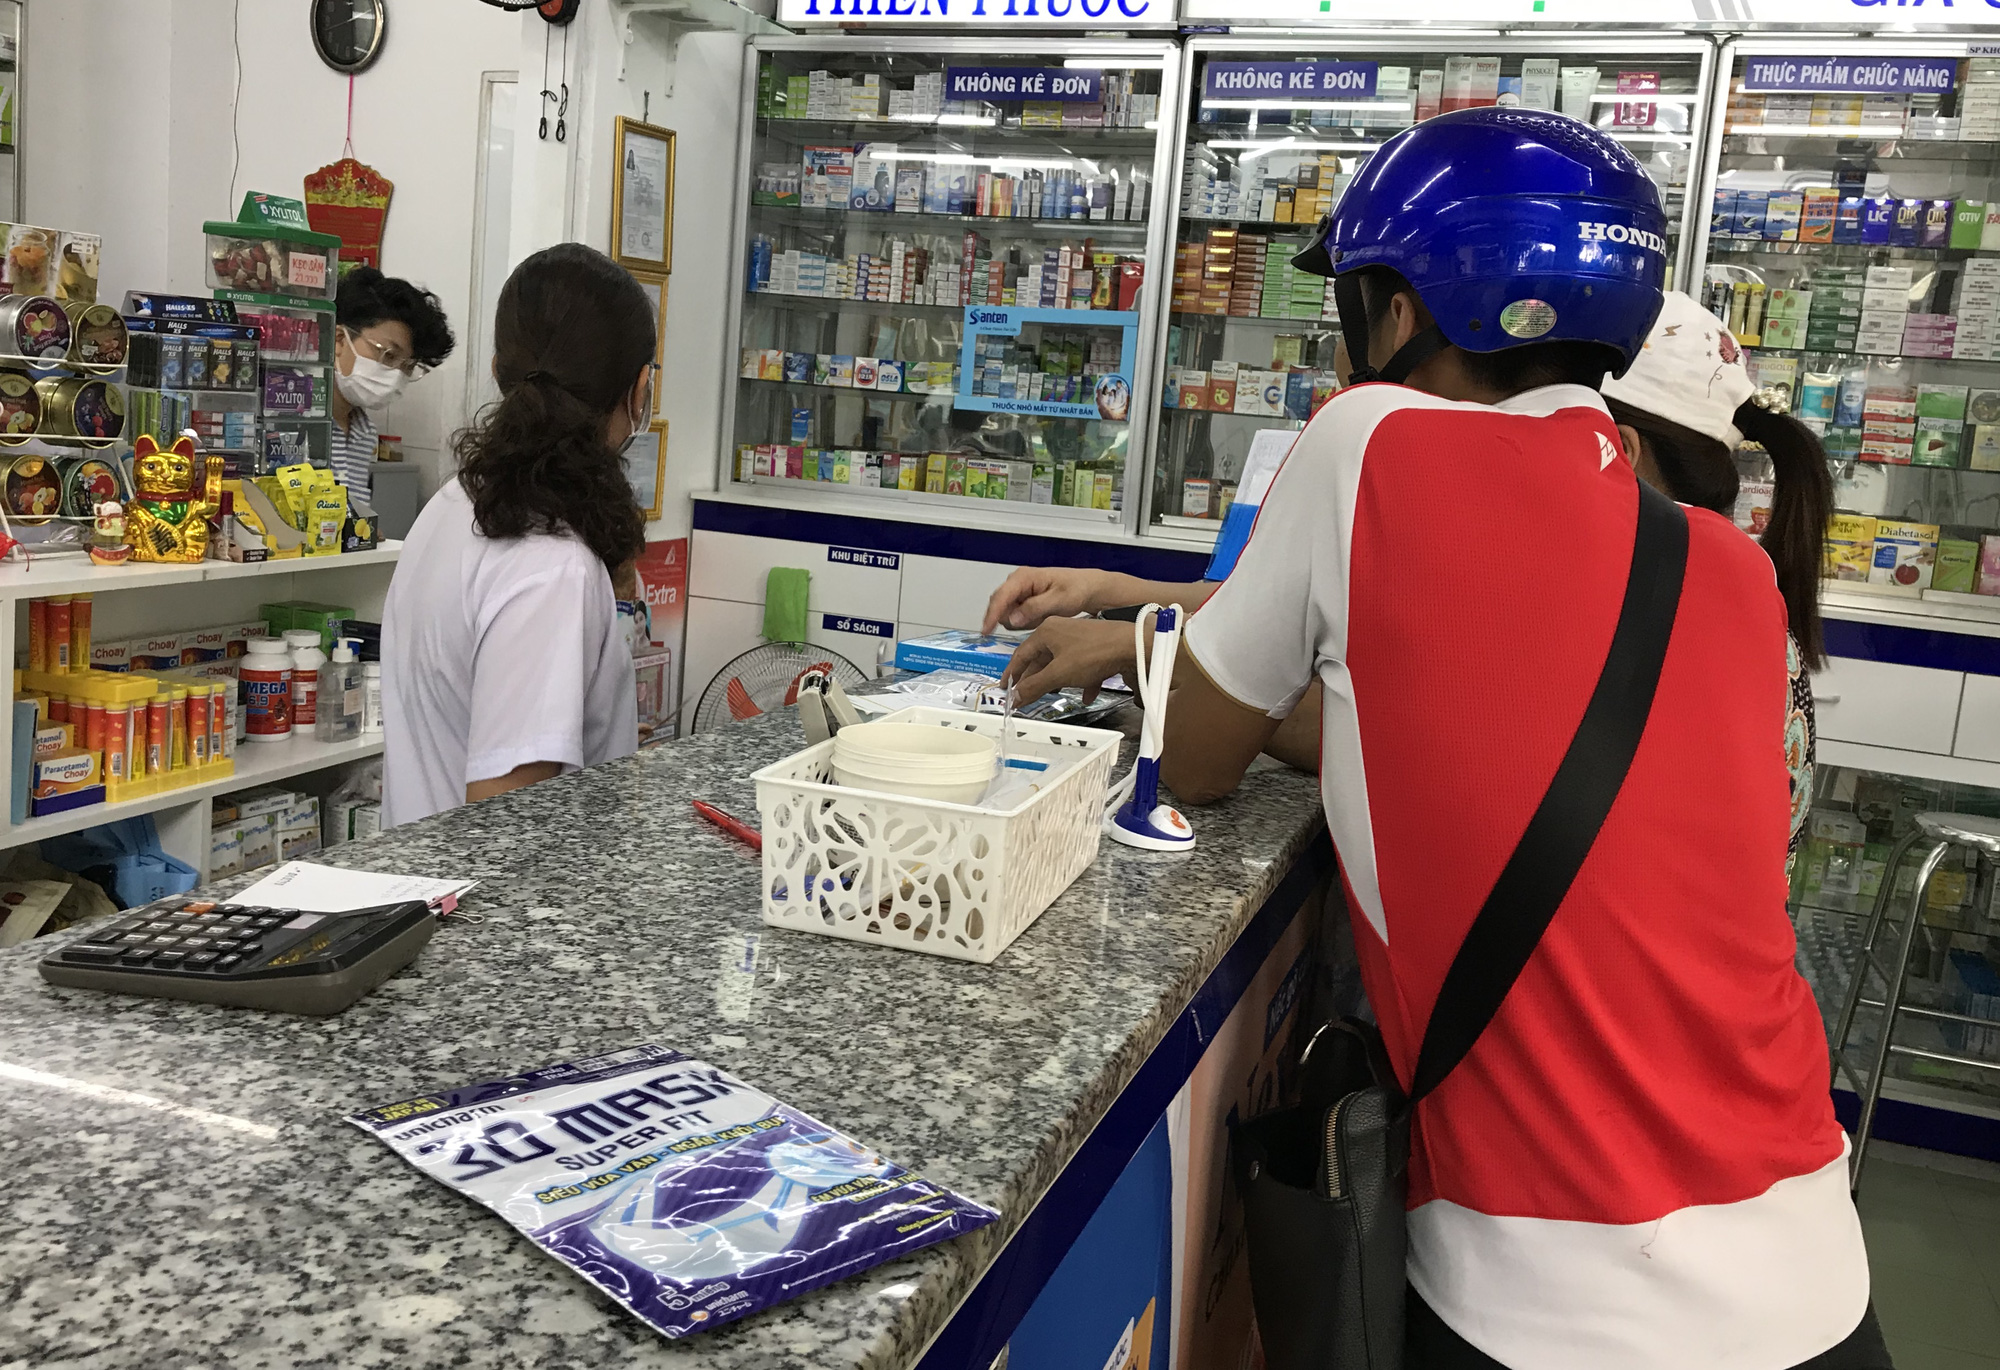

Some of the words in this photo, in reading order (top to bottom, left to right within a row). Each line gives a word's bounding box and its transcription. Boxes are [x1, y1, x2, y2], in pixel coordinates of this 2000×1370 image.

[1215, 67, 1283, 89] KHÔNG
[1289, 66, 1316, 89] KÊ
[1323, 70, 1366, 89] ĐƠN
[1753, 62, 1796, 86] THỰC
[1800, 57, 1849, 84] PHẨM
[1853, 62, 1899, 86] CHỨC
[1903, 64, 1950, 88] NĂNG
[954, 72, 1016, 93] KHÔNG
[1021, 73, 1045, 93] KÊ
[1052, 76, 1091, 95] ĐƠN
[269, 205, 304, 222] XYLITOL
[1868, 210, 1889, 222] LIC
[1959, 212, 1981, 222] OTIV
[1578, 221, 1667, 258] HONDA
[232, 293, 255, 302] XYLITOL
[168, 321, 188, 330] HALLS
[162, 344, 183, 352] HALLS
[188, 345, 208, 353] HALLS
[213, 348, 232, 356] HALLS
[237, 349, 256, 357] HALLS
[992, 401, 1016, 410] THUỐC
[316, 499, 341, 510] Ricola
[1880, 525, 1935, 540] Diabetasol
[831, 550, 851, 561] KHU
[853, 552, 874, 565] BIỆT
[876, 555, 896, 567] TRỮ
[646, 584, 677, 606] Extra
[240, 626, 267, 638] Choay
[837, 617, 852, 630] SỔ
[853, 621, 880, 634] SÁCH
[196, 632, 223, 644] Choay
[147, 639, 177, 651] Choay
[95, 647, 126, 659] Choay
[206, 665, 235, 677] Choay
[244, 681, 288, 695] MEGA
[36, 742, 63, 752] Choay
[44, 757, 91, 775] Paracetamol
[63, 767, 91, 780] Choay
[542, 1069, 581, 1081] TRANG
[383, 1101, 441, 1121] JAPAN
[545, 1068, 745, 1144] MASK
[394, 1104, 507, 1141] unicharm
[555, 1125, 668, 1171] SUPER
[661, 1109, 713, 1132] FIT
[536, 1183, 583, 1204] SIÊU
[656, 1284, 693, 1310] 5
[705, 1290, 749, 1310] unicharm
